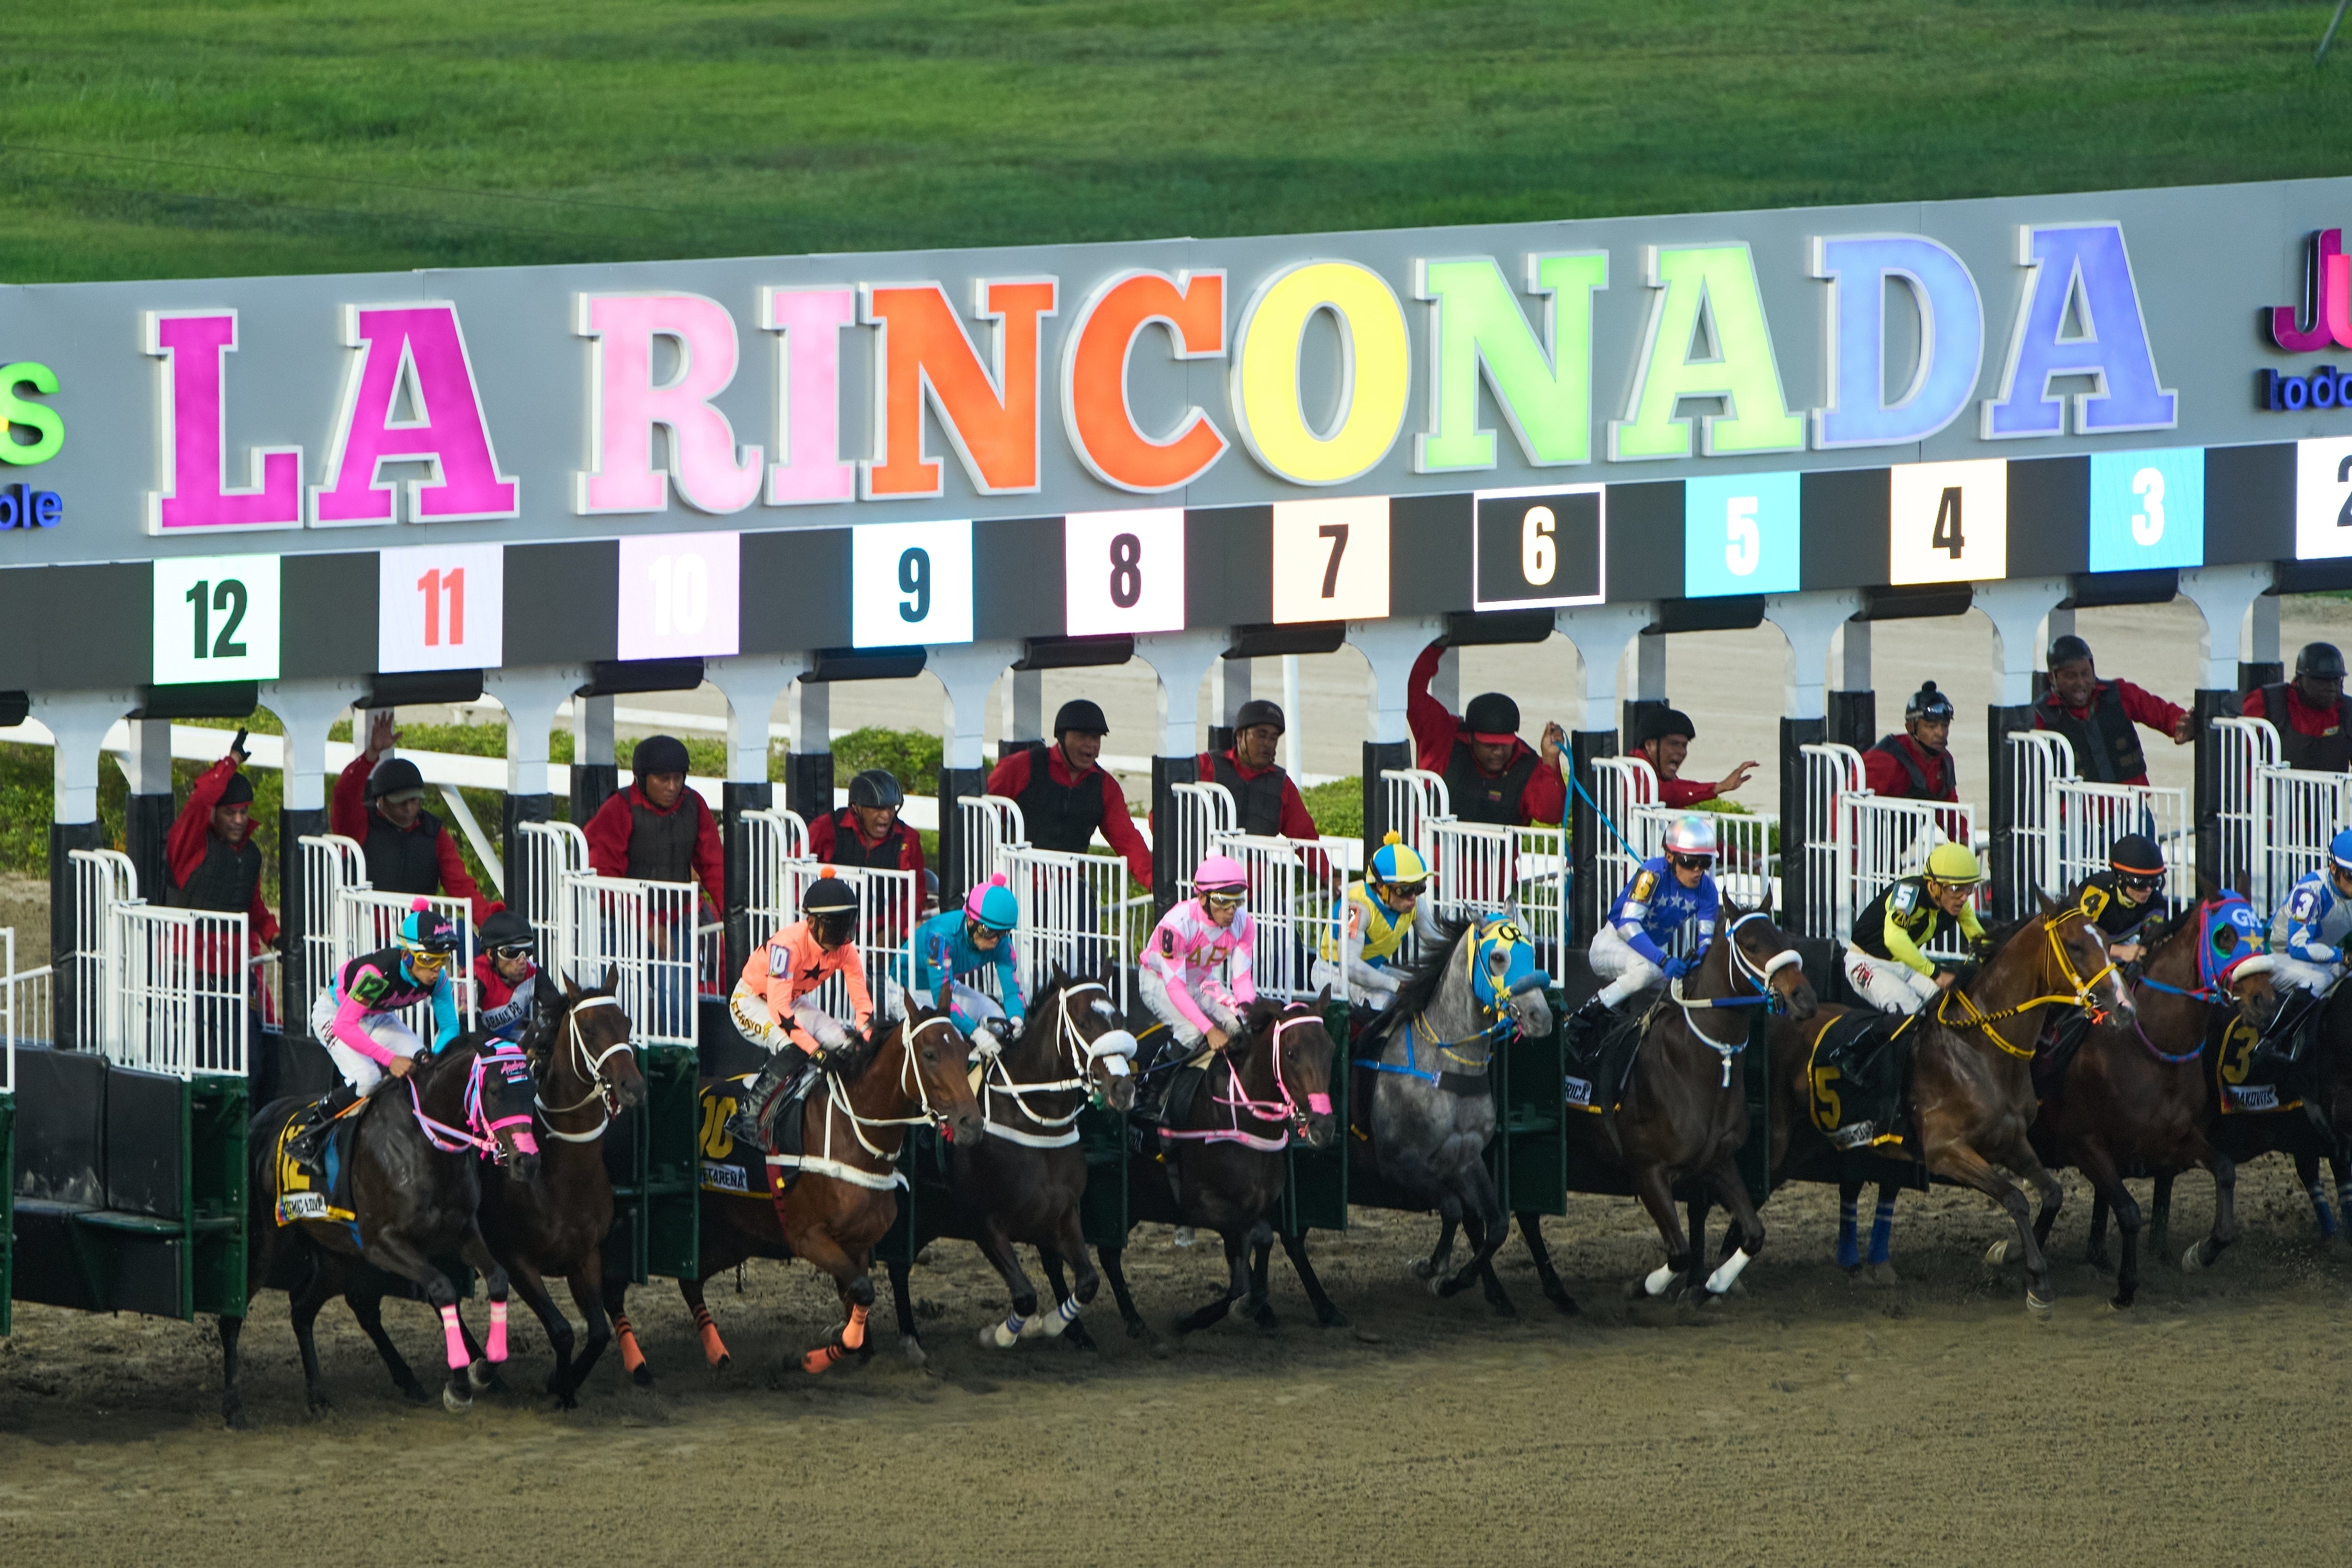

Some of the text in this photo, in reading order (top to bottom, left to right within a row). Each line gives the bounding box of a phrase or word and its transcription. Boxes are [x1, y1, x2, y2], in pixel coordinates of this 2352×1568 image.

[146, 220, 2178, 536] LA RINCONADA
[1725, 496, 1760, 576] 5
[1932, 486, 1965, 560] 4
[2131, 468, 2165, 547] 3
[1109, 533, 1142, 609] 8
[1318, 524, 1349, 599] 7
[1521, 505, 1556, 586] 6
[417, 568, 464, 647] 11
[647, 553, 708, 636] 10
[897, 547, 931, 623] 9
[186, 579, 248, 659] 12
[1634, 871, 1654, 899] 6
[1895, 883, 1914, 909] 5
[2084, 893, 2102, 915] 4
[2296, 892, 2314, 919] 3
[930, 936, 940, 961] 9
[1162, 928, 1174, 953] 8
[2231, 908, 2263, 928] GM
[355, 975, 384, 1000] 12
[769, 944, 788, 974] 10
[2222, 1026, 2259, 1084] 3
[1566, 1082, 1587, 1101] RICA
[1815, 1066, 1841, 1130] 5
[699, 1095, 738, 1159] 10
